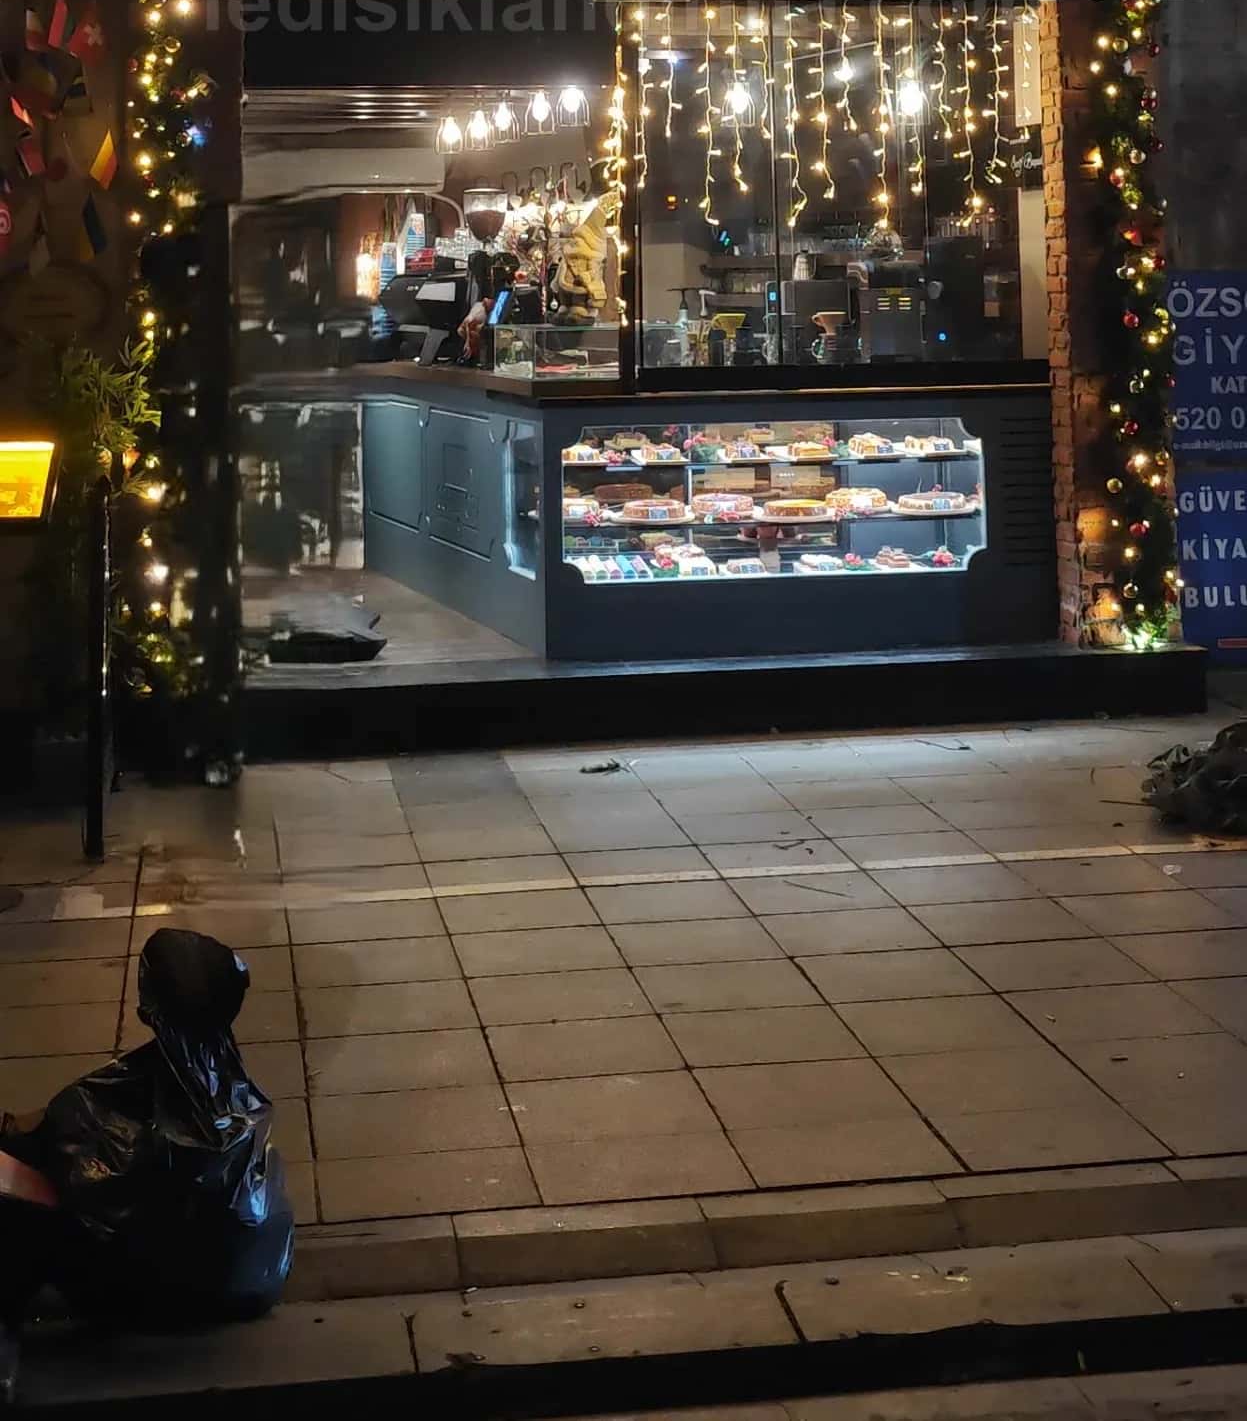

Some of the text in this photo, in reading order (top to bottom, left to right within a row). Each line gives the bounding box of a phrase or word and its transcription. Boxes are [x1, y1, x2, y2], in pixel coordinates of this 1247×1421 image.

[1167, 281, 1247, 318] ÖZS
[1175, 407, 1222, 430] 520
[1179, 486, 1247, 513] GÜVE
[1182, 534, 1247, 561] KİYA
